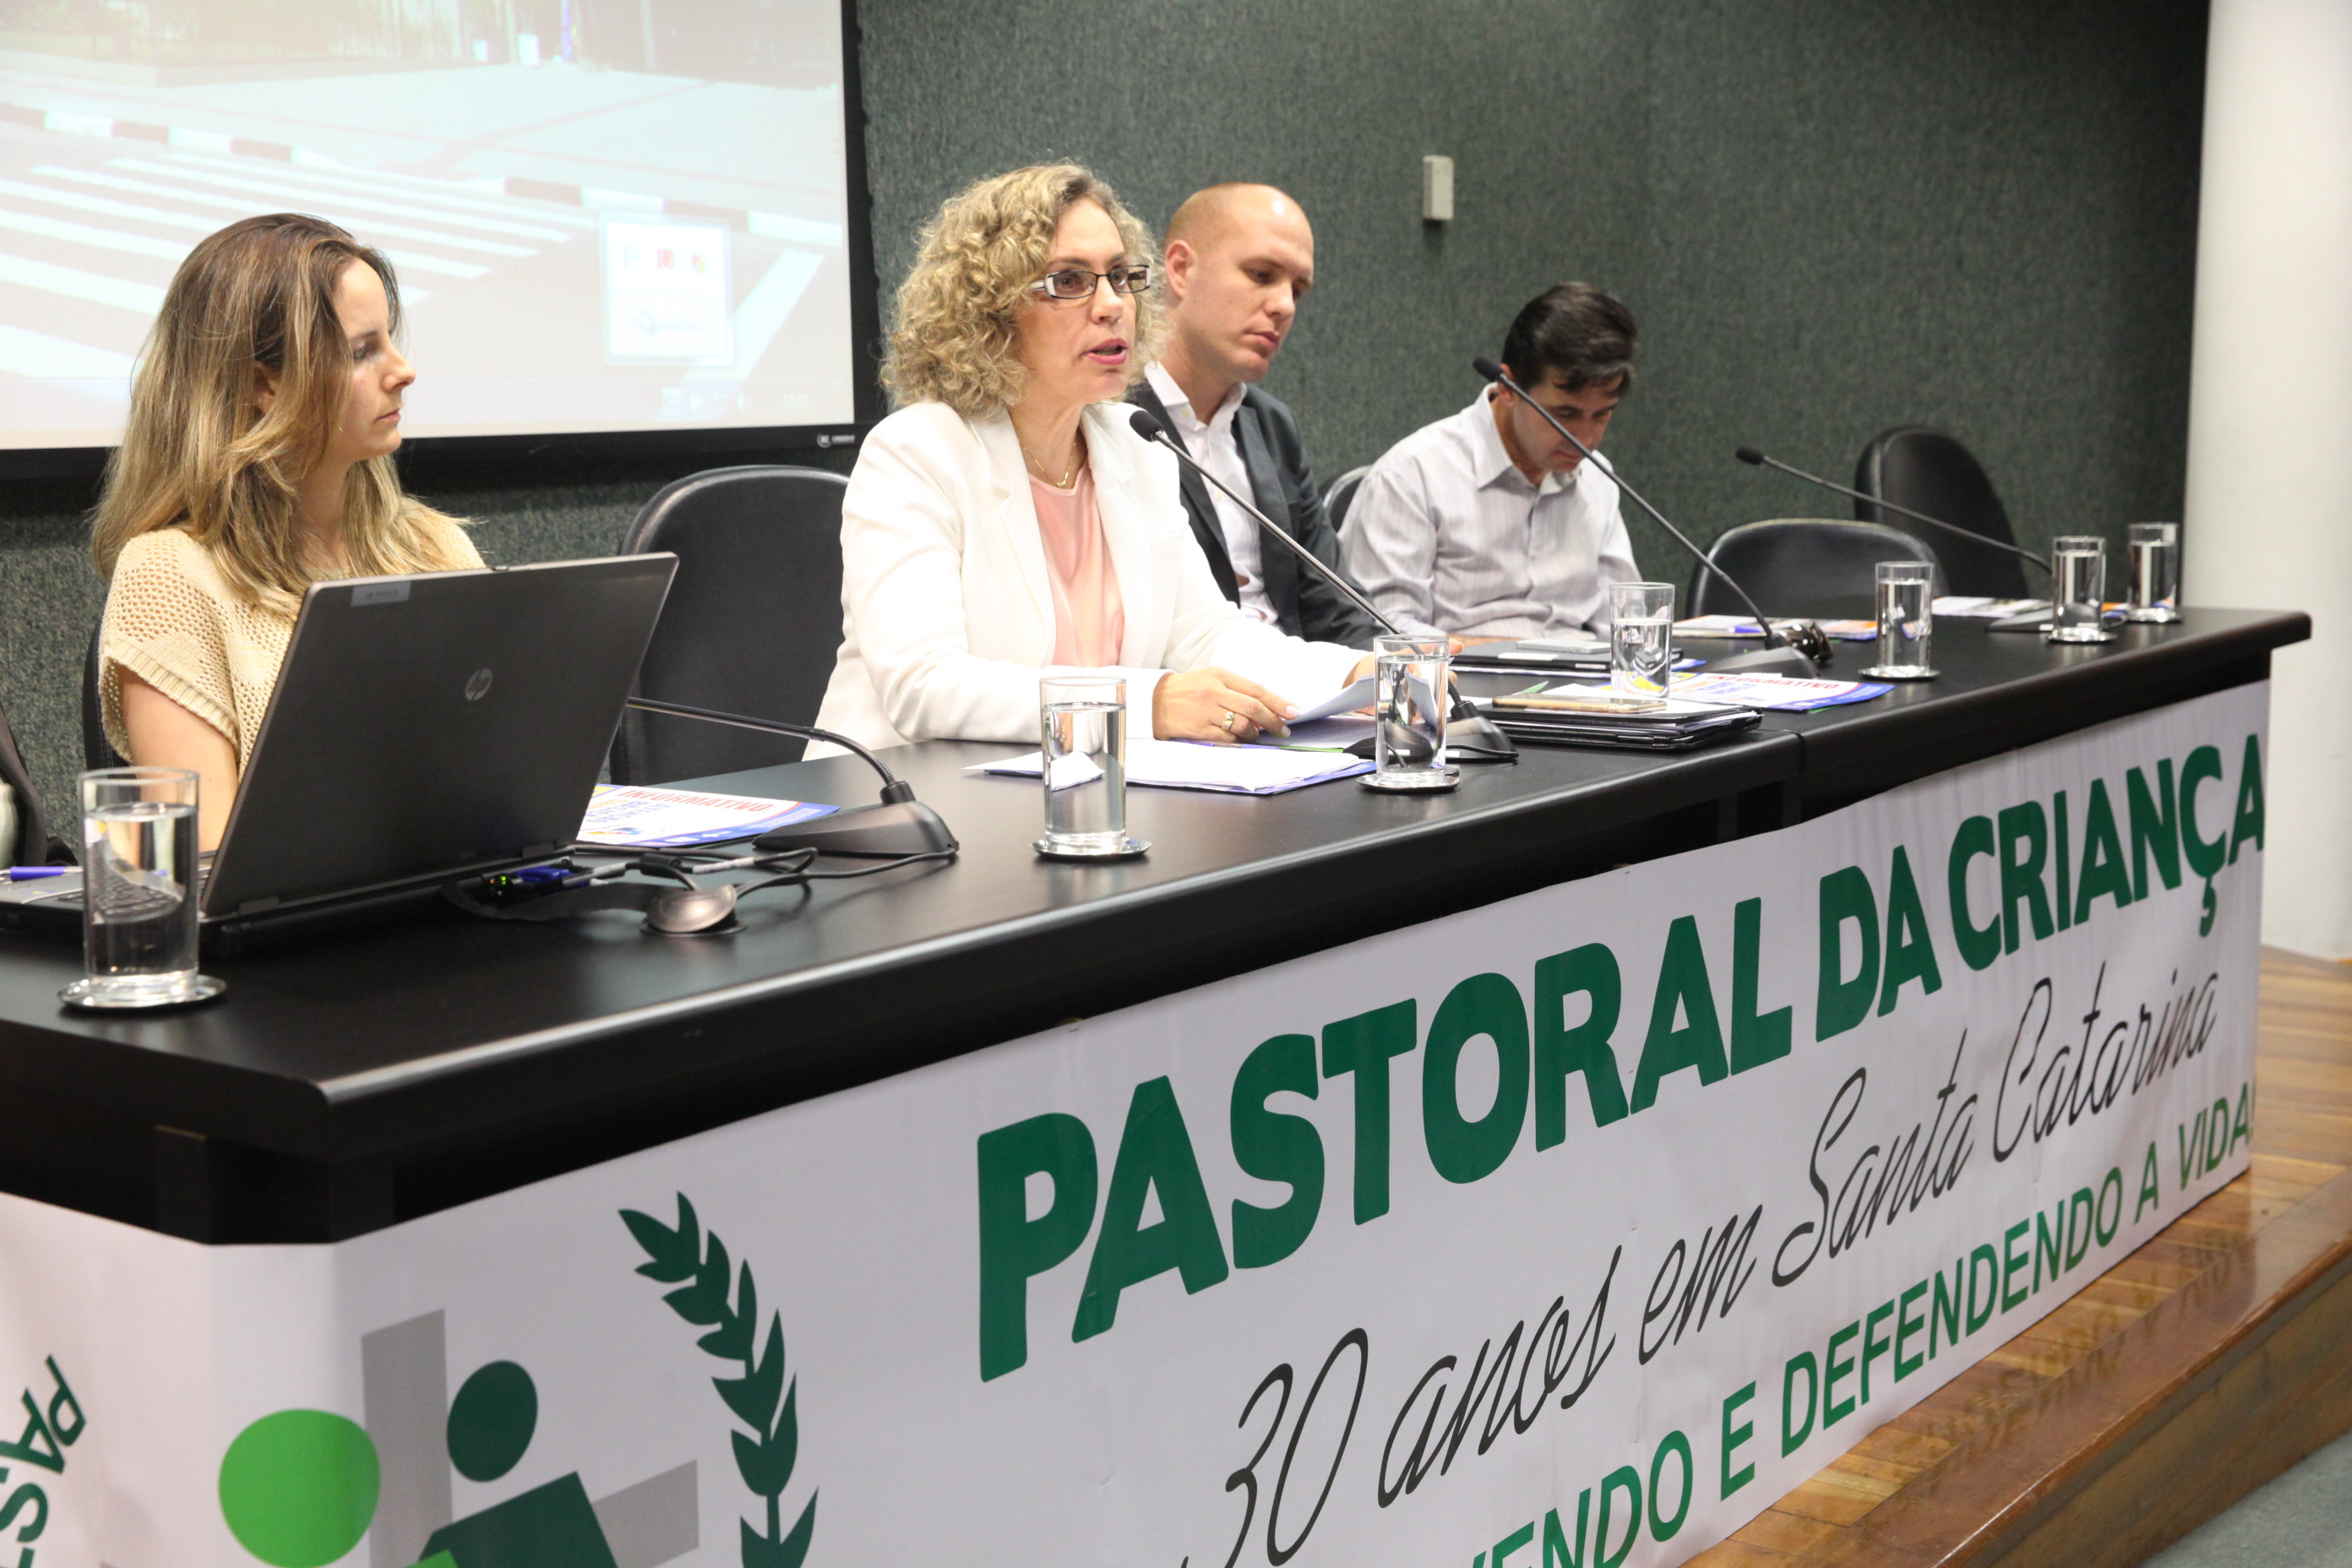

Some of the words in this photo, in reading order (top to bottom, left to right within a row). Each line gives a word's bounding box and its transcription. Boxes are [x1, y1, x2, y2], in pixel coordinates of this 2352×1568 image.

[616, 789, 775, 812] INFORMATIVO
[1707, 674, 1841, 689] INFORMATIVO
[977, 898, 1792, 1382] PASTORAL
[1816, 846, 1941, 1043] DA
[1948, 733, 2266, 971] CRIANÇA
[1180, 1328, 1369, 1568] 30
[1378, 1245, 1621, 1508] anos
[1639, 1205, 1762, 1365] em
[1772, 1028, 1979, 1288] Santa
[1994, 960, 2220, 1162] Catarina
[1473, 1431, 1693, 1568] NDO
[1722, 1382, 1756, 1500] E
[1783, 1167, 2122, 1457] DEFENDENDO
[2135, 1141, 2159, 1224] A
